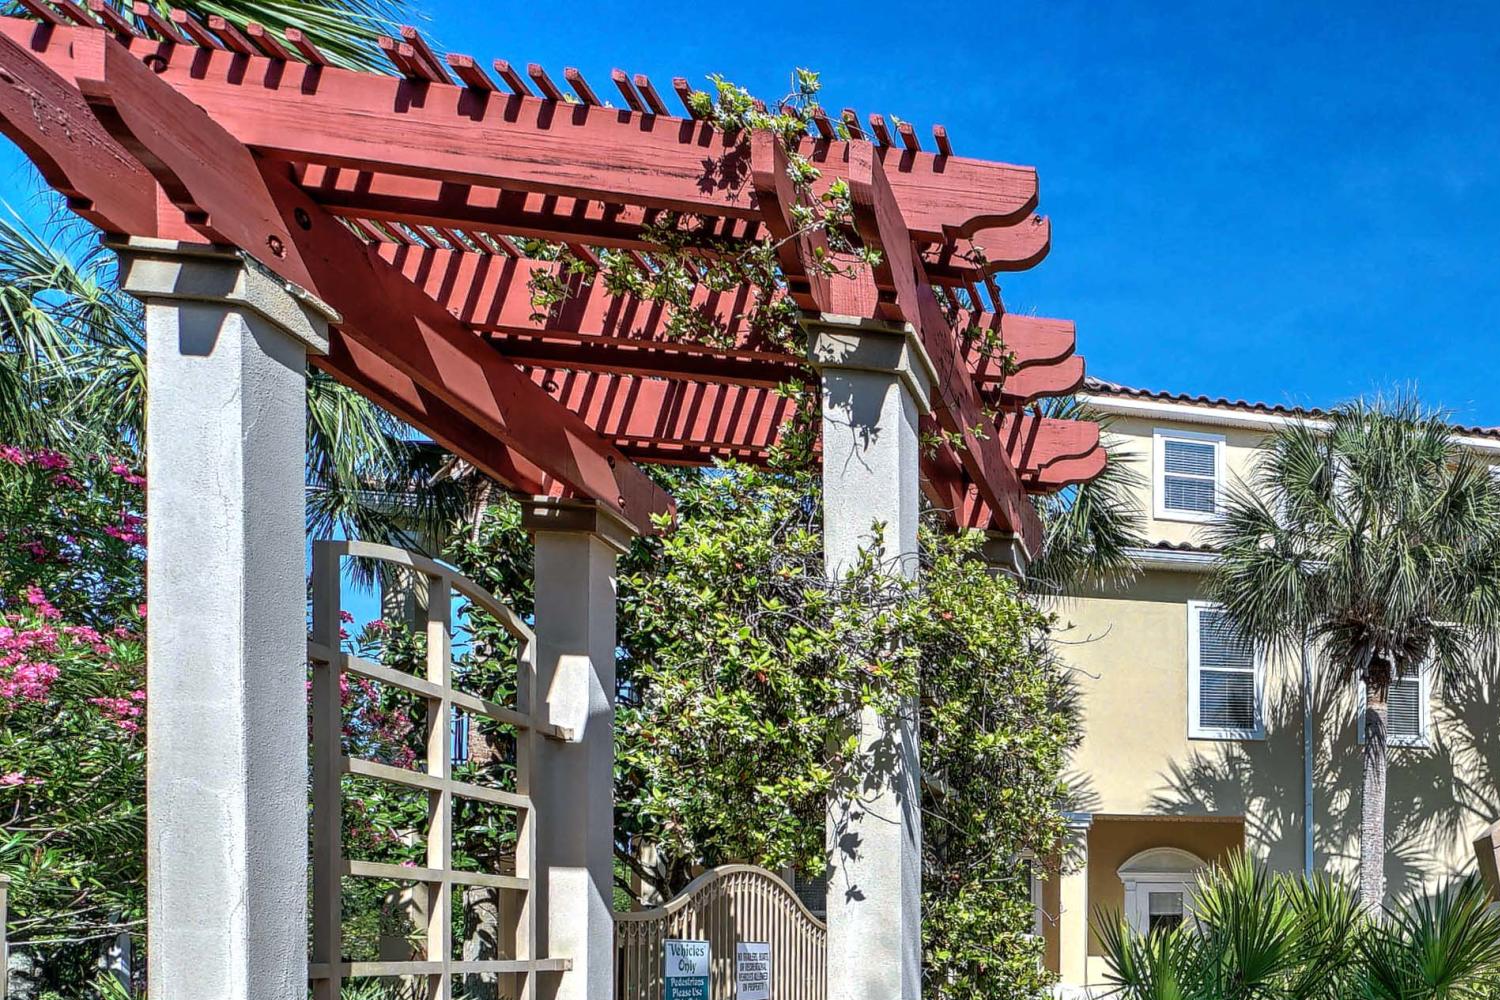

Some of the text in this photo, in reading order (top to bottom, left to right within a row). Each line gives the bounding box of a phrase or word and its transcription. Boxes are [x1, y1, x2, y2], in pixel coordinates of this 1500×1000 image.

[668, 943, 704, 958] Vehicles
[678, 959, 696, 974] Only
[670, 978, 704, 987] Pedestrians
[672, 987, 703, 998] Please Use
